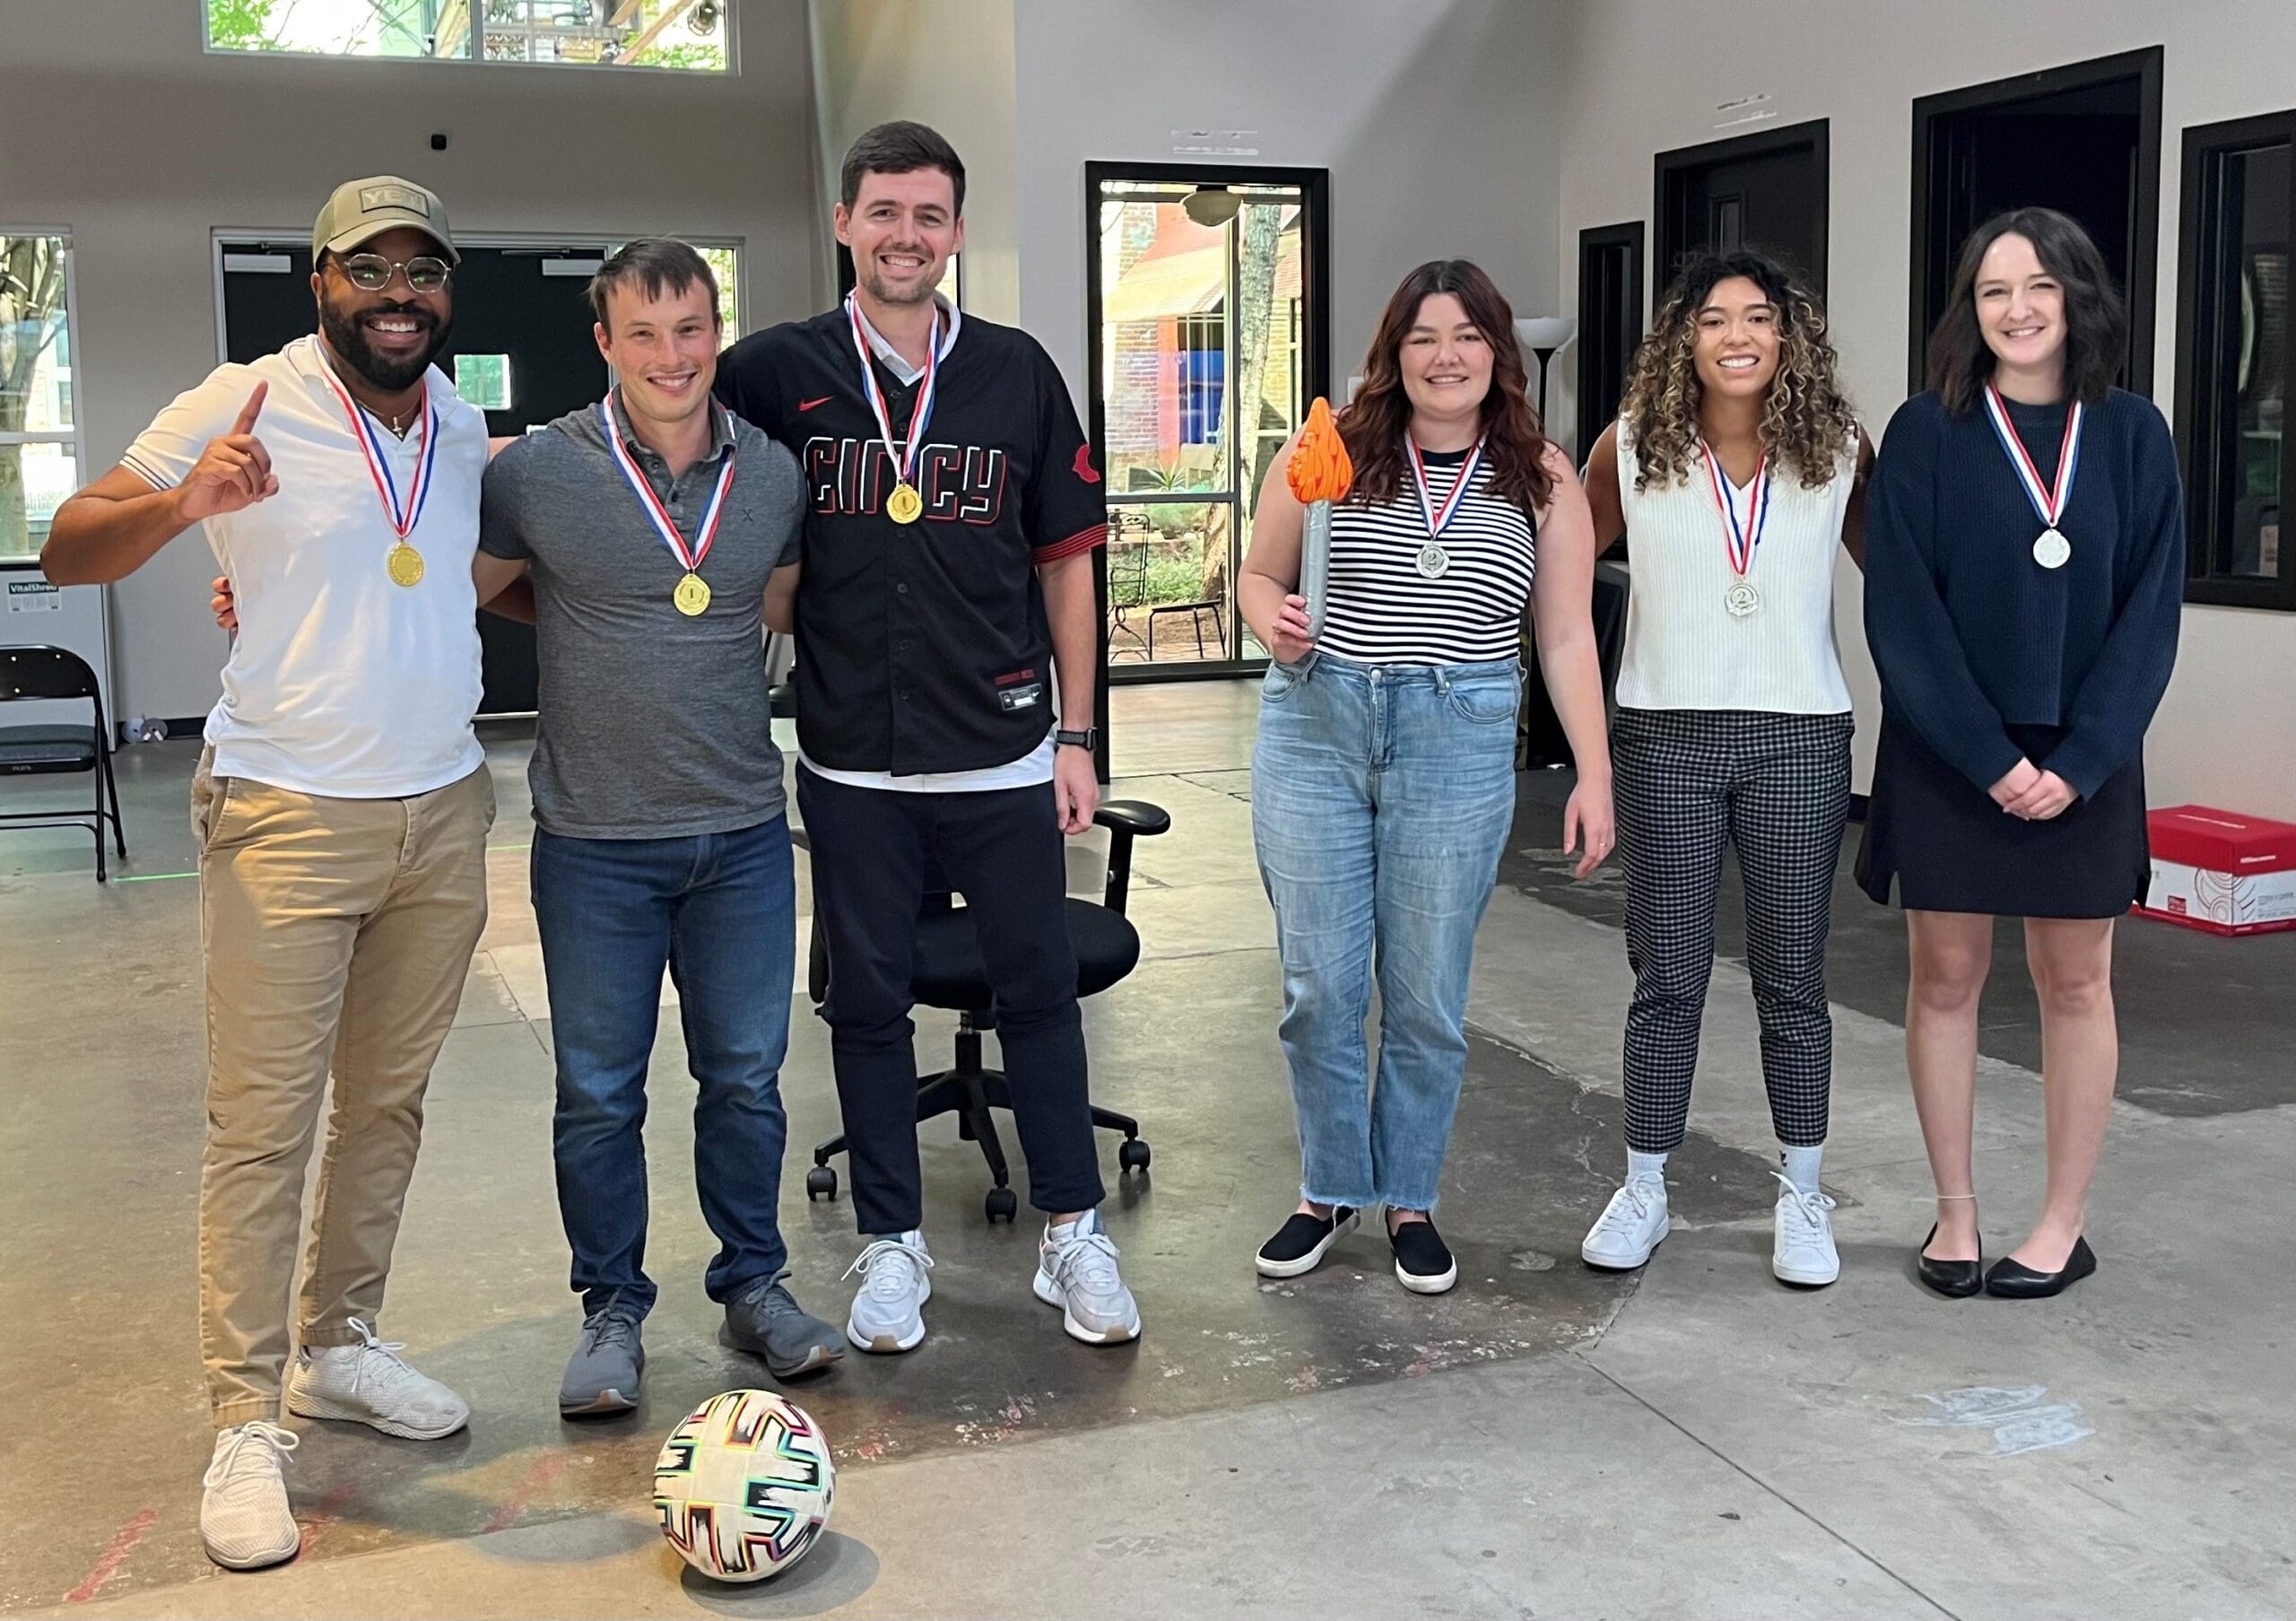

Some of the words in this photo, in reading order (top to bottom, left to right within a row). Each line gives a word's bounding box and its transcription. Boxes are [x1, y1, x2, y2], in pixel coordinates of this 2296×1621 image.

[804, 437, 1007, 525] CINCY
[1427, 553, 1437, 566] 2
[1737, 590, 1746, 604] 2
